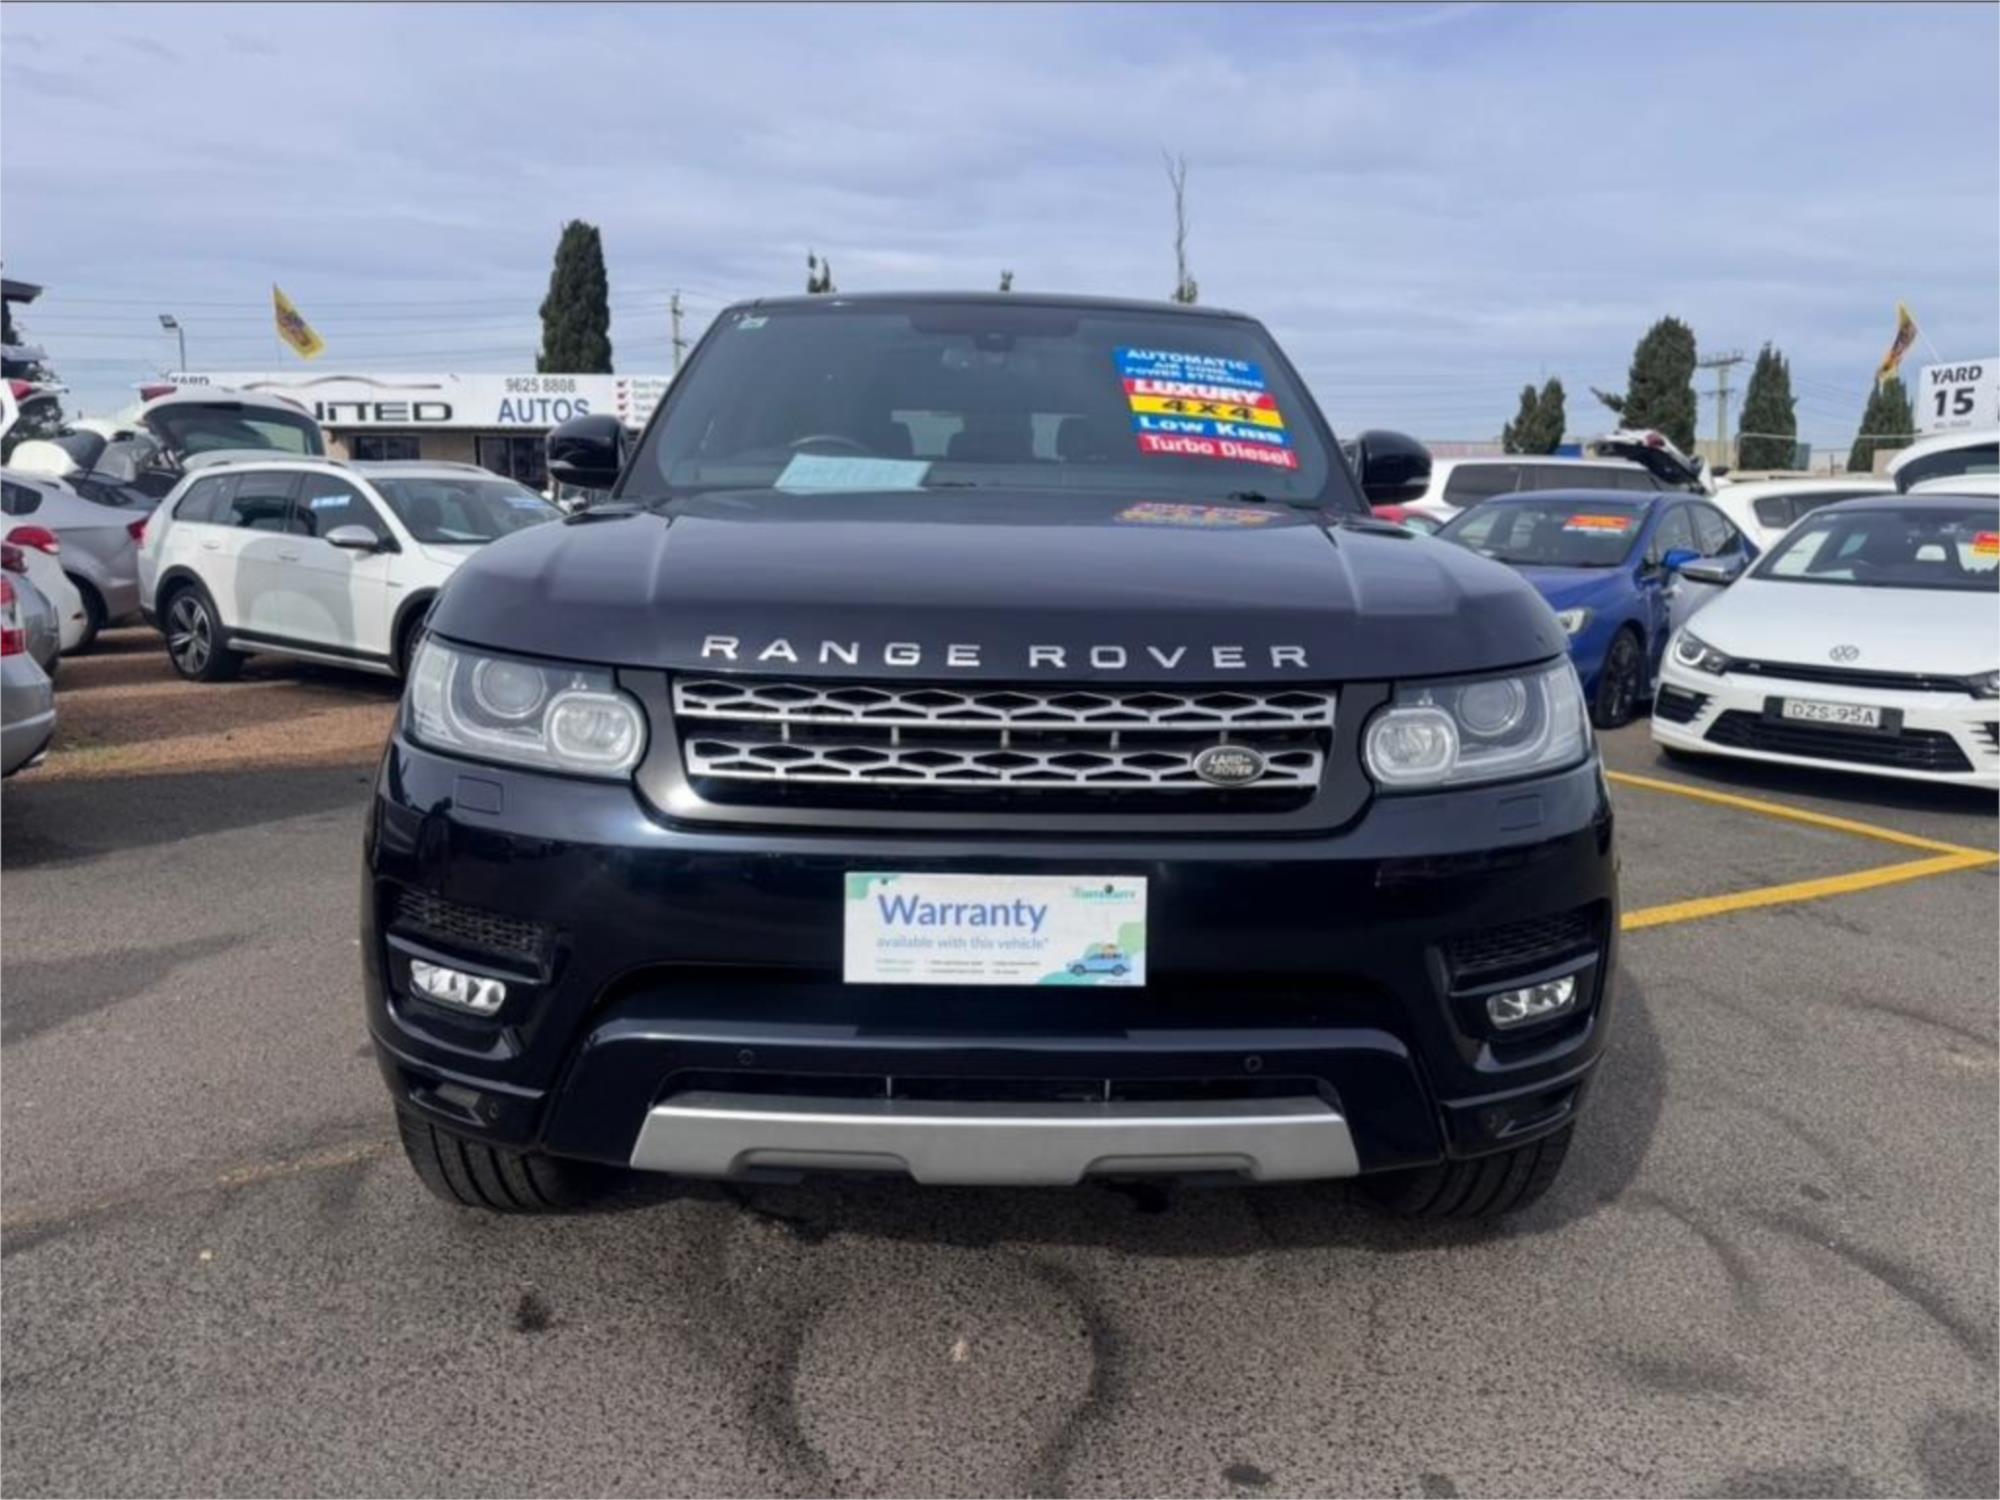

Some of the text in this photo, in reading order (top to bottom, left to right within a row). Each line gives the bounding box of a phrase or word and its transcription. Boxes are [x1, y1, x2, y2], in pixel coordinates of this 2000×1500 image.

[1126, 349, 1249, 372] AUTOMATIC
[505, 377, 540, 393] 9625
[1931, 365, 1983, 385] YARD
[1134, 379, 1264, 404] LUXURY
[1934, 386, 1975, 417] 15
[498, 397, 590, 424] AUTOS
[1140, 416, 1284, 444] Low Kms
[1144, 435, 1291, 467] Turbo Diesel
[700, 635, 1310, 669] RANGE ROVER
[877, 894, 1048, 933] Warranty
[876, 936, 933, 948] available
[936, 936, 967, 949] with
[970, 937, 995, 949] this
